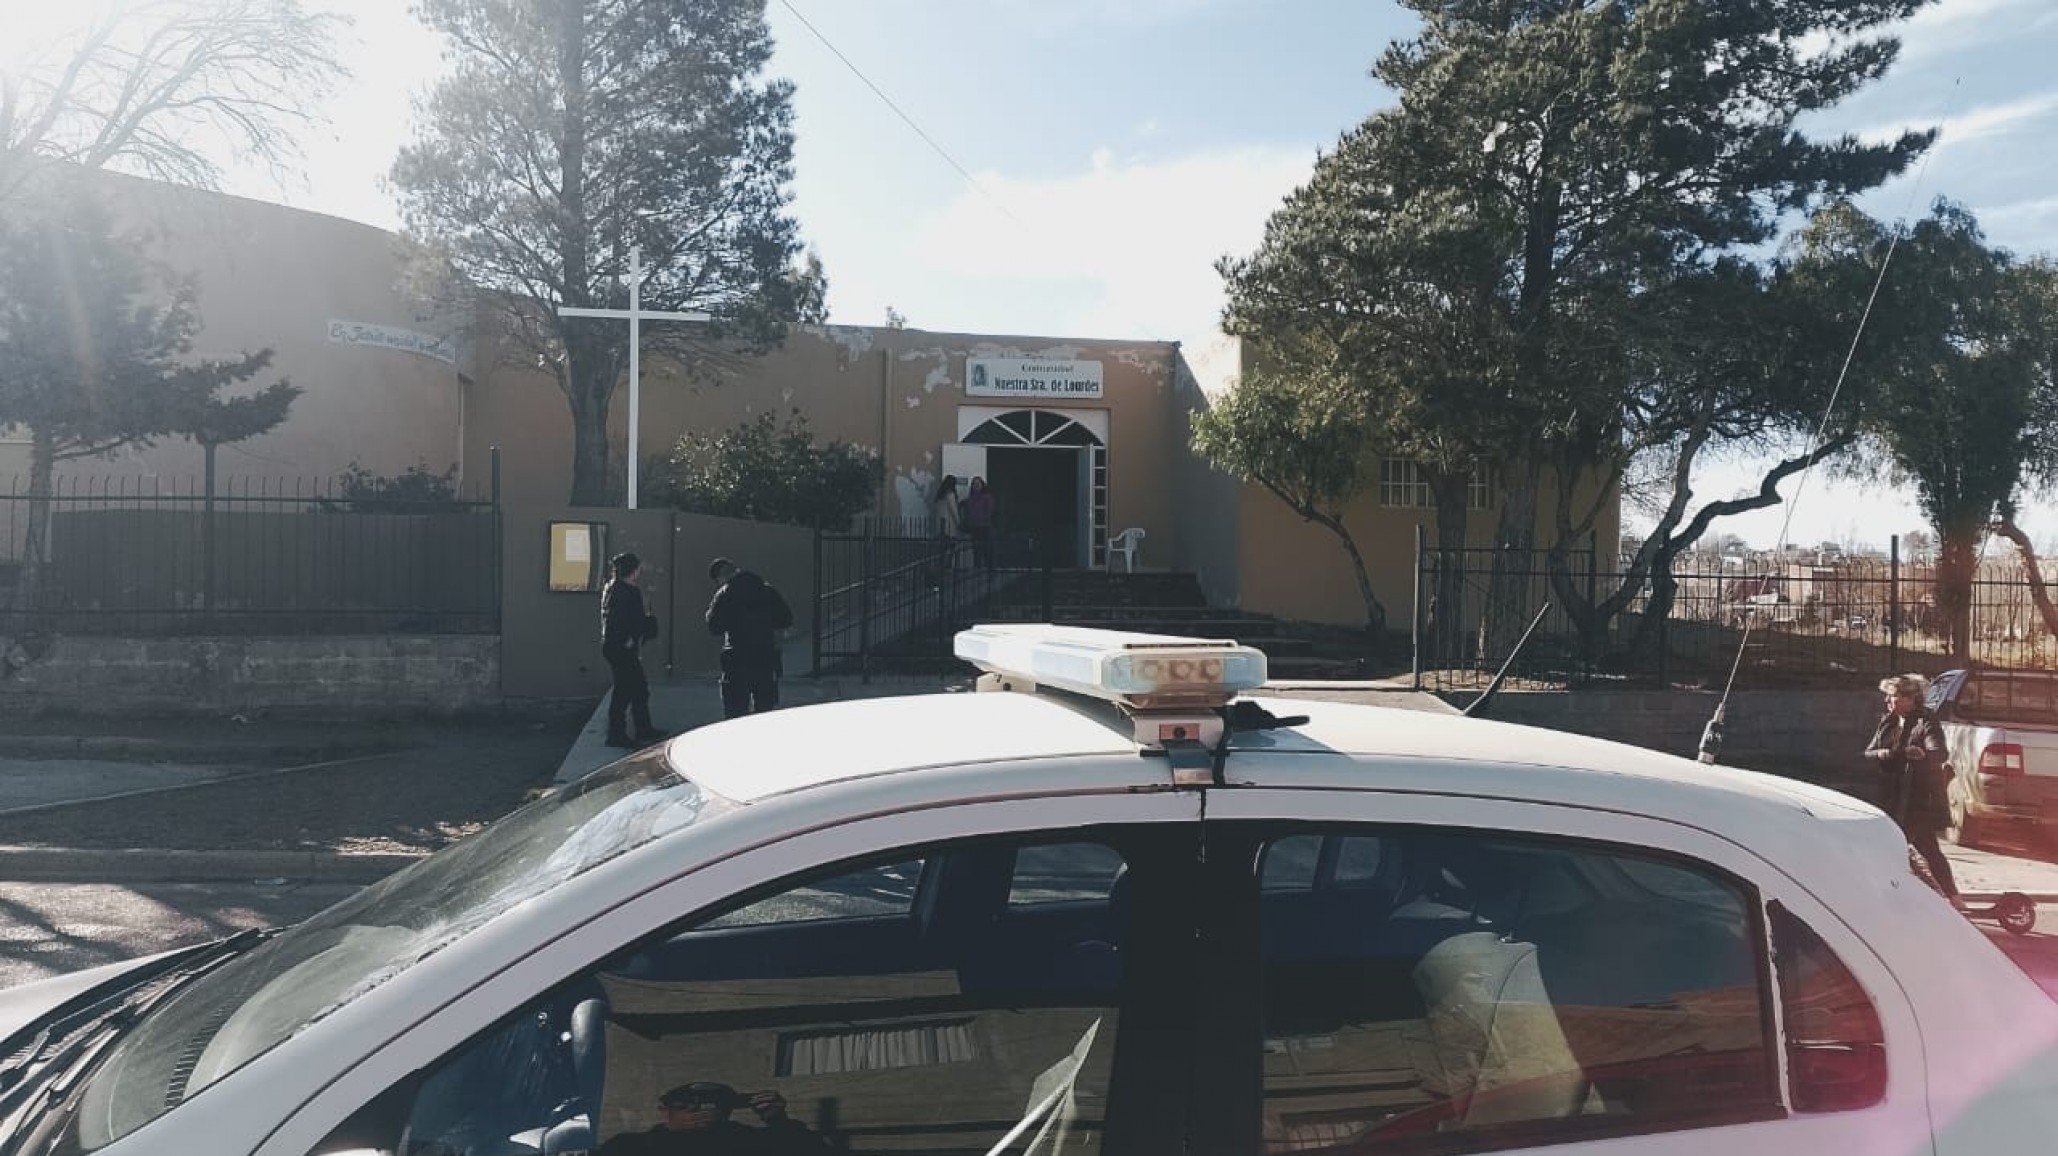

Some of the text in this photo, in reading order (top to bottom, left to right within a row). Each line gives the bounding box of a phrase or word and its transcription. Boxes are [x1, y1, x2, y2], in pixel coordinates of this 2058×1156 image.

[994, 377, 1028, 391] Nuestra
[1051, 379, 1062, 391] de
[1064, 379, 1099, 392] Lourdes
